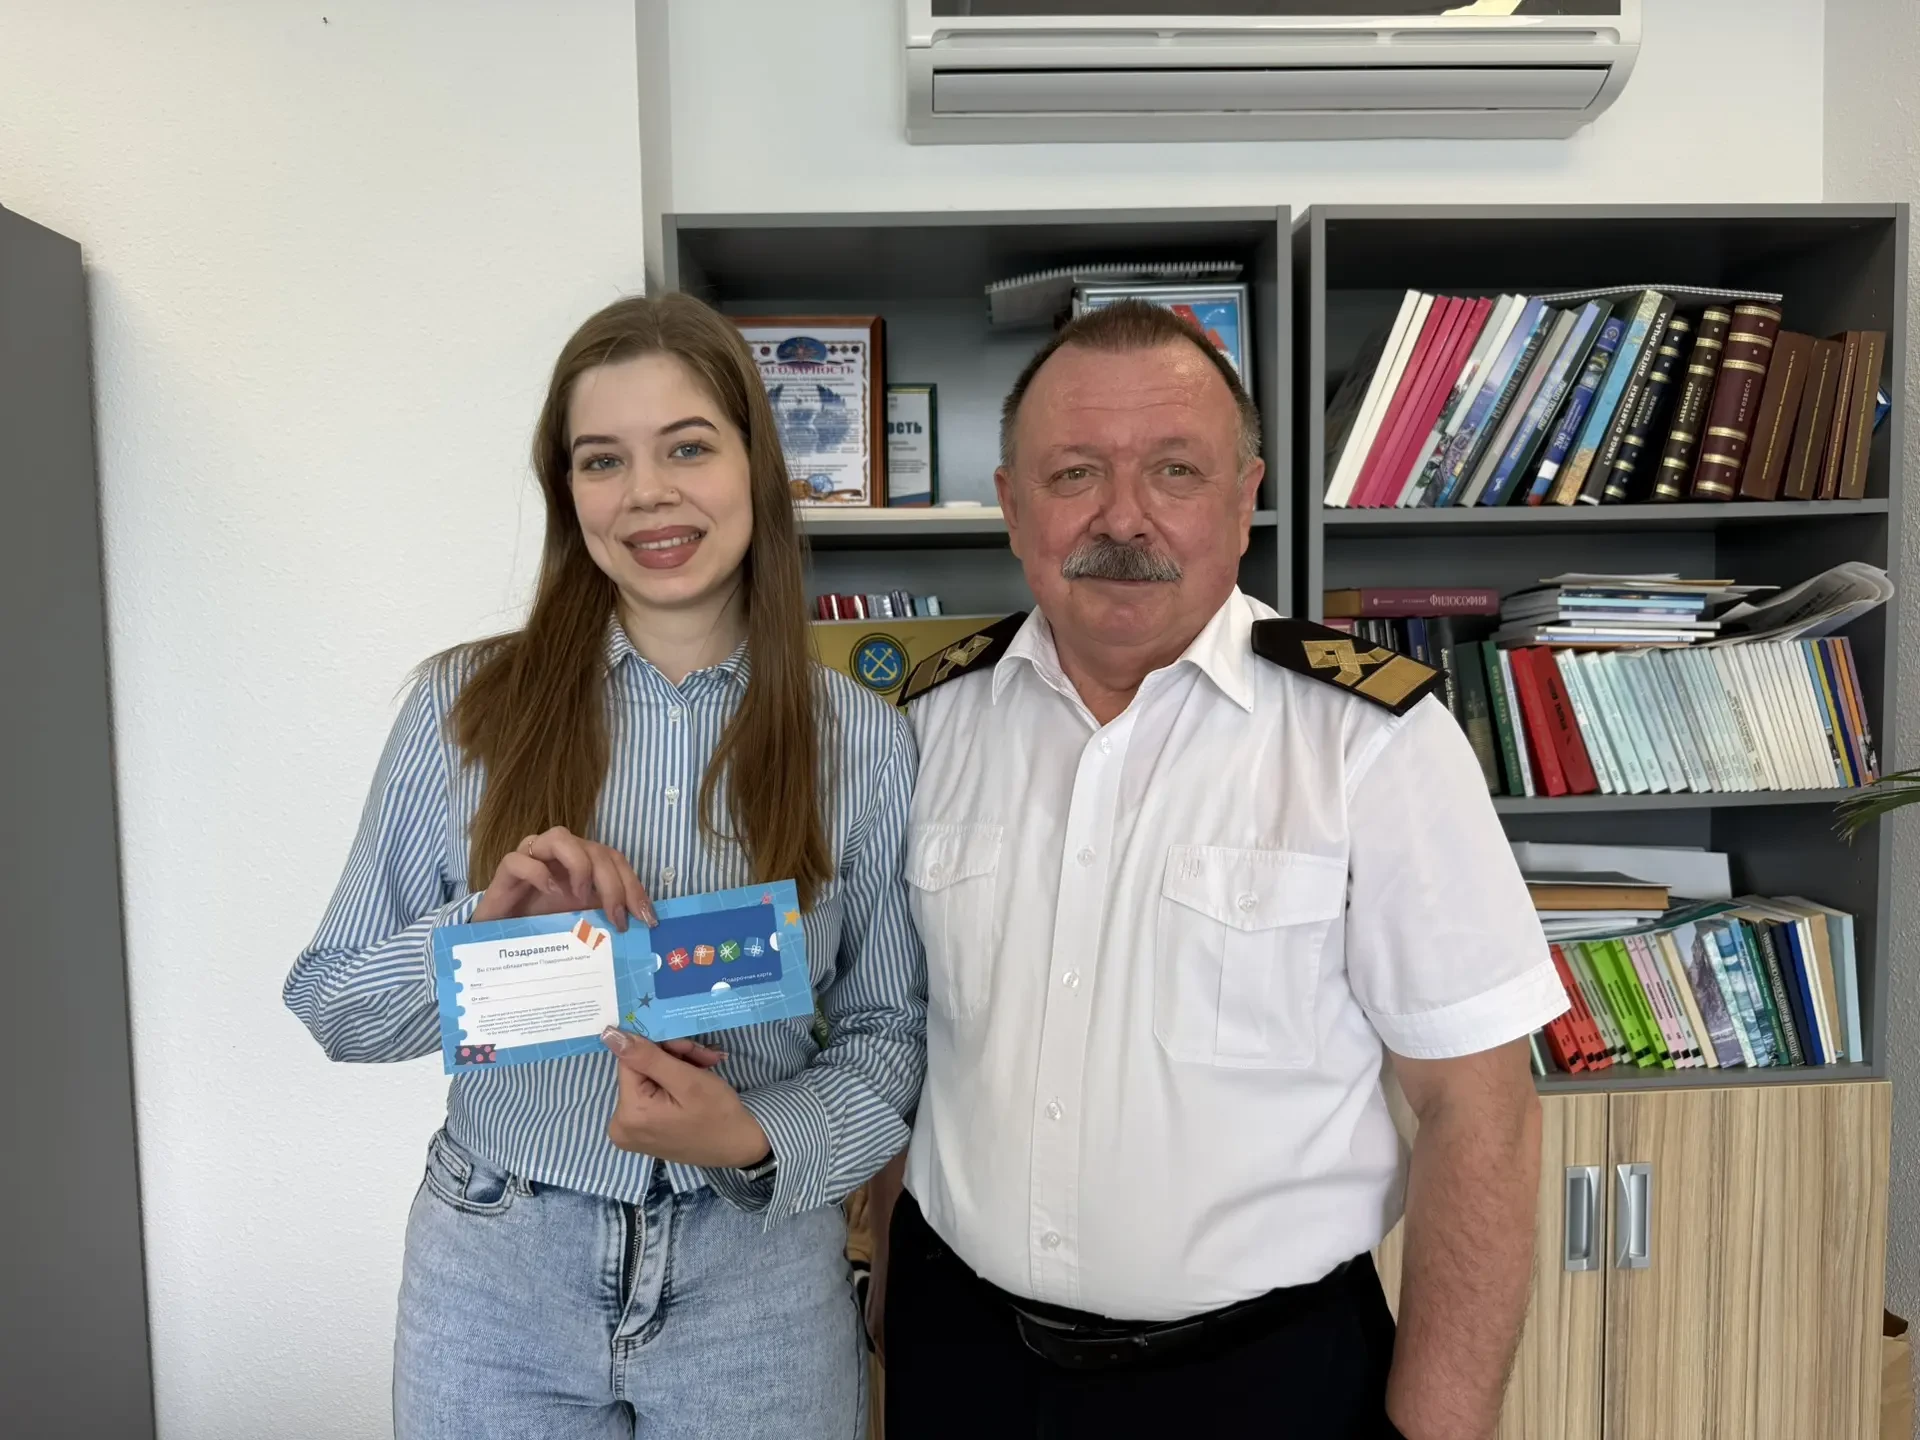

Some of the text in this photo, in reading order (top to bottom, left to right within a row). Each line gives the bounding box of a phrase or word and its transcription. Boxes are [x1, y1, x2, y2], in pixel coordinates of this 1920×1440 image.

[1638, 312, 1667, 377] АНГЕЛ АРЦАХА
[760, 365, 854, 375] АГОДАРНОСТЬ
[1678, 382, 1694, 424] АЛЕКСАНДР
[1604, 385, 1638, 466] L'ANGE D'ARTSAKH
[1430, 594, 1487, 606] ФИЛОСОФИЯ
[499, 944, 570, 959] Поздравляем
[722, 971, 772, 984] Подарочная карта
